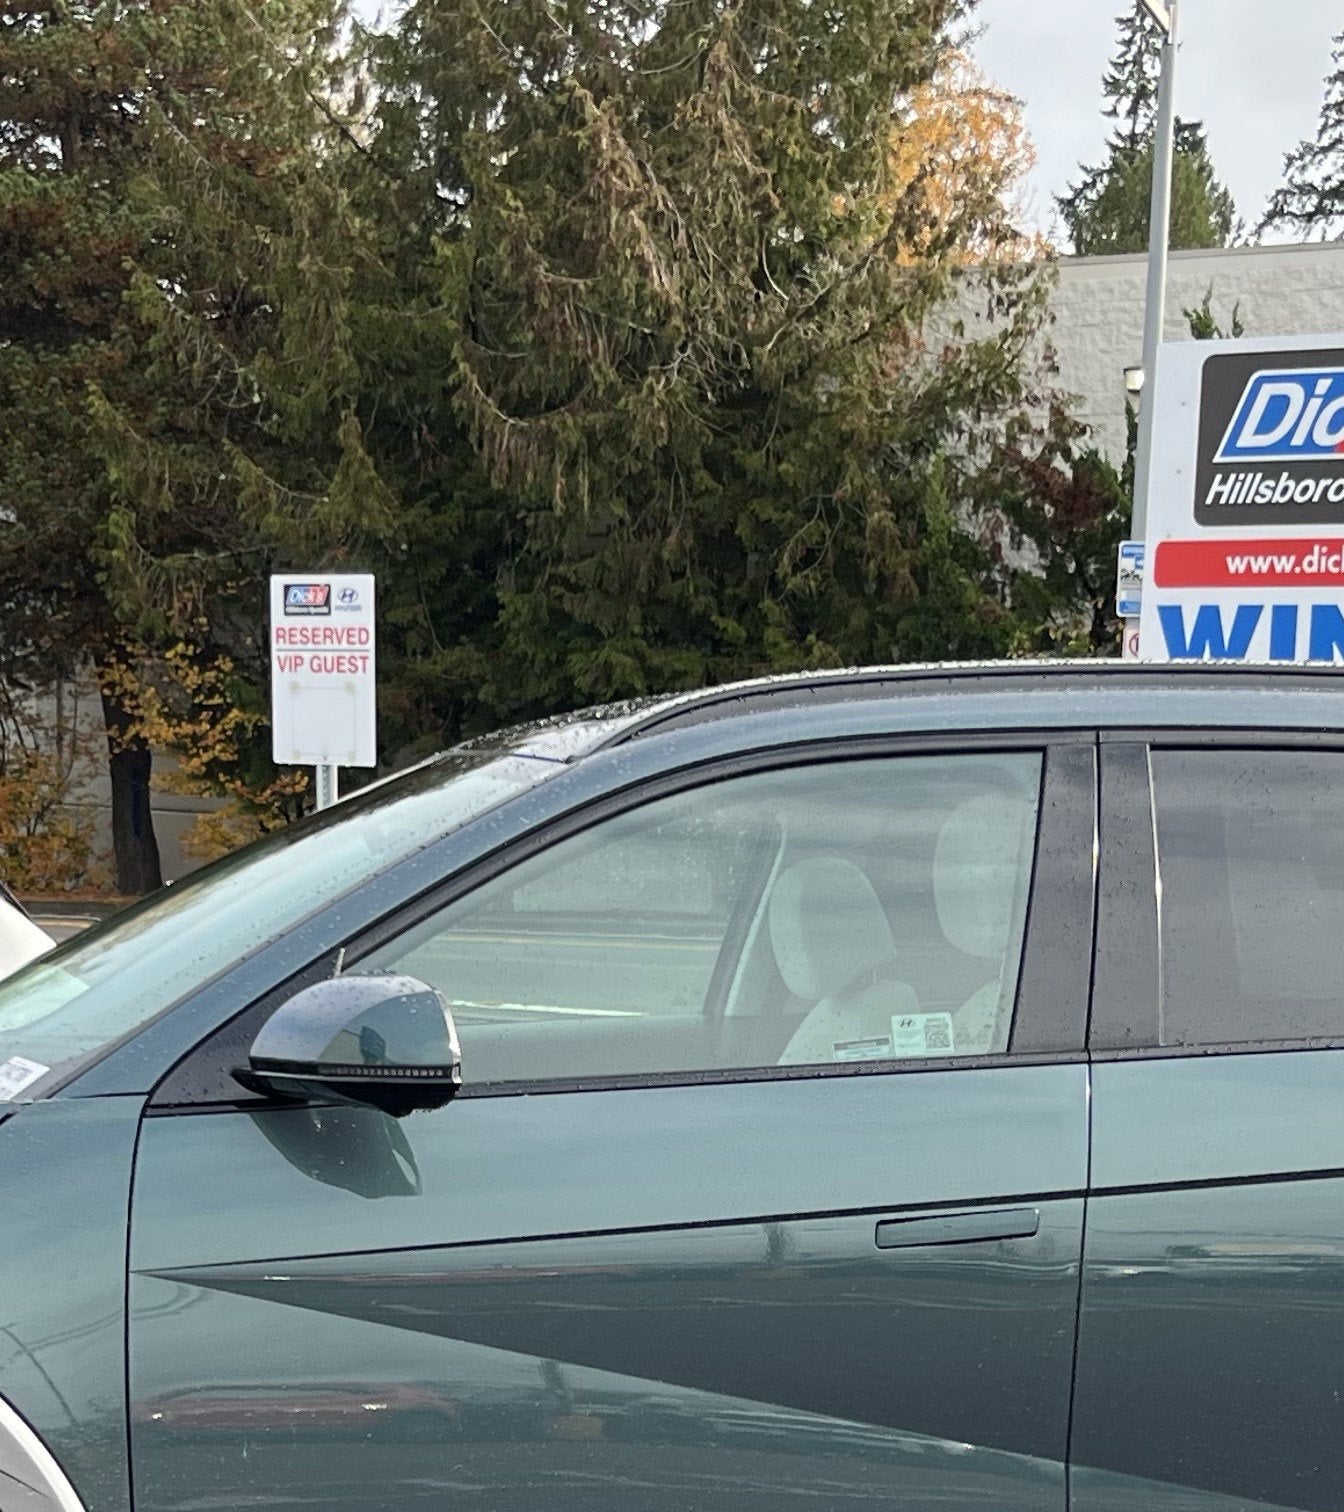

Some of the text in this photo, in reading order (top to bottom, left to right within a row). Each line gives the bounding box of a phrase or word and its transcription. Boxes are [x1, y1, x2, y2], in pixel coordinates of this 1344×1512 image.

[275, 627, 370, 645] RESERVED
[277, 655, 370, 674] VIP GUEST
